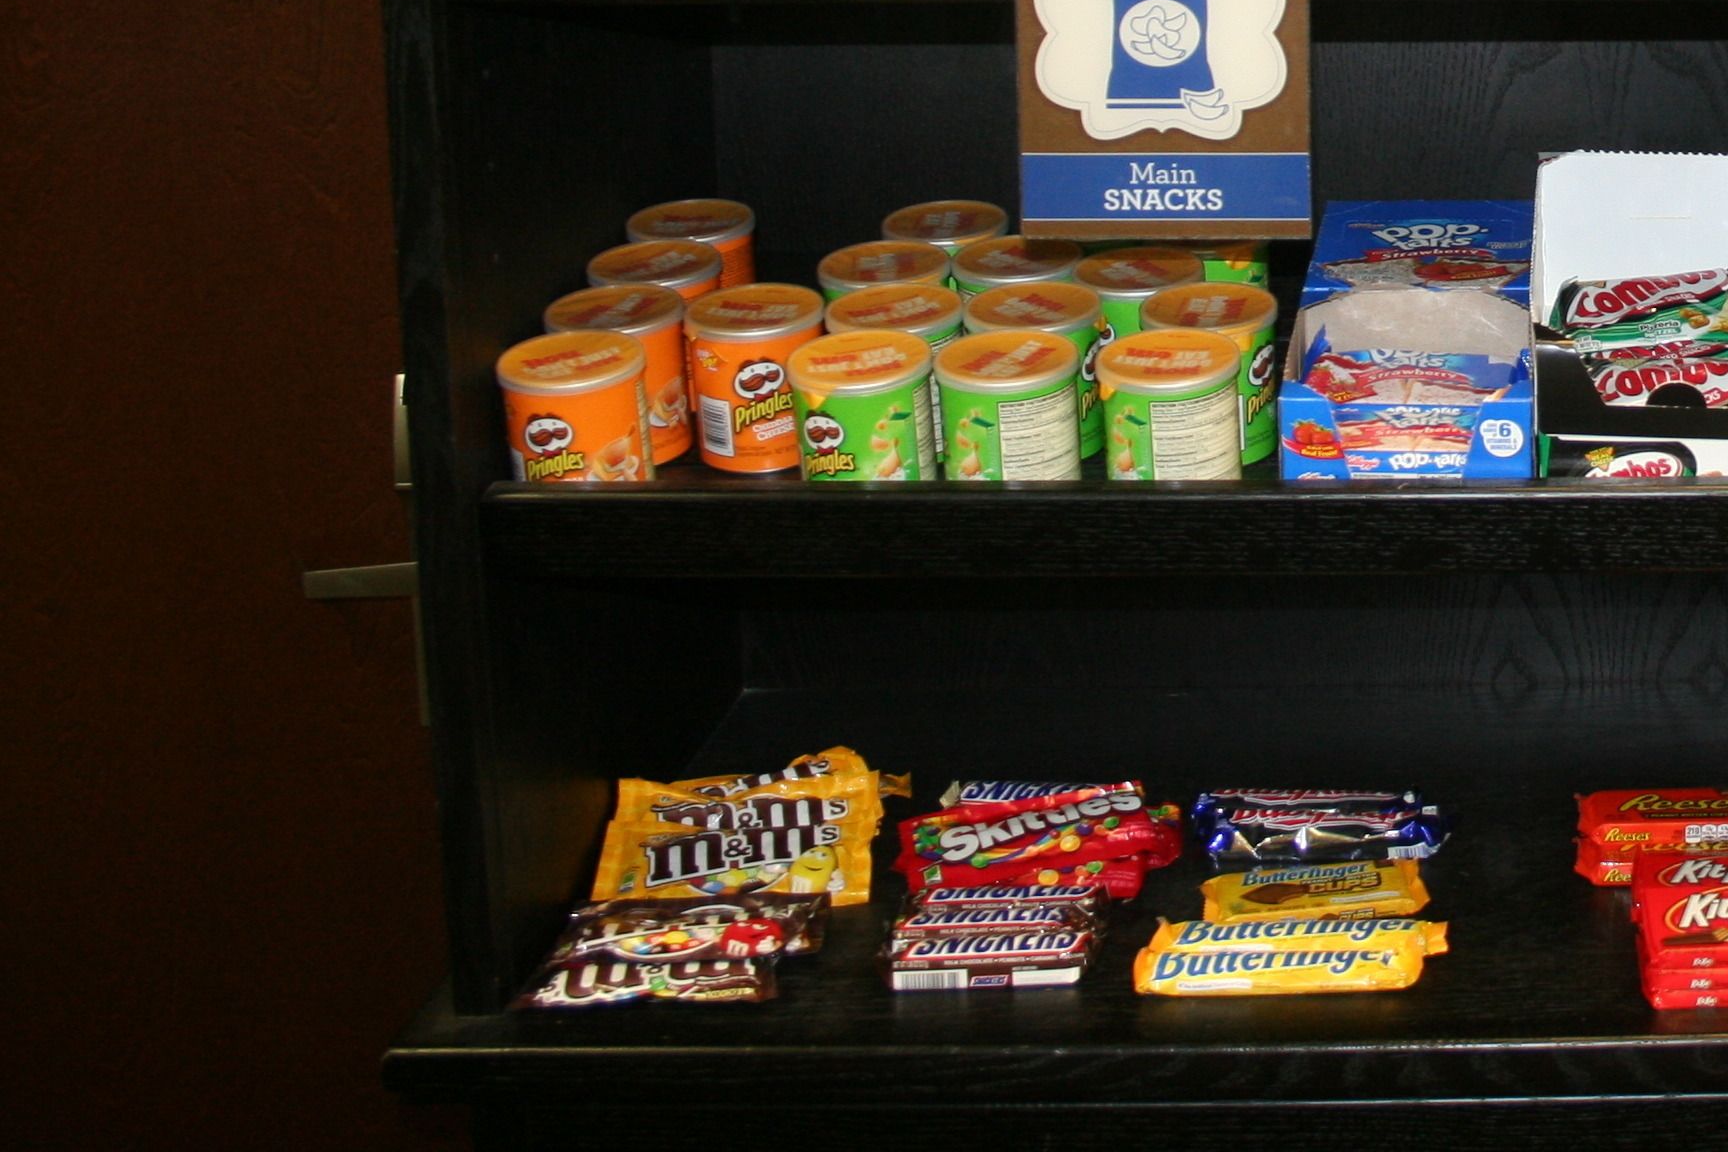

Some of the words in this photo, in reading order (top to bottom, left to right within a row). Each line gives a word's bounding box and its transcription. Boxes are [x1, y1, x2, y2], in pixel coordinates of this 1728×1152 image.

[1130, 162, 1197, 185] Main
[1104, 189, 1223, 211] SNACKS
[1638, 319, 1680, 331] Pizzeria
[1367, 368, 1457, 380] Strawberry
[735, 392, 793, 432] Pringles
[1499, 423, 1512, 437] 6
[526, 451, 584, 480] Pringles
[806, 450, 855, 475] Pringles
[939, 791, 1143, 862] Skittles
[646, 827, 841, 886] m&m's
[1242, 863, 1369, 886] Butterfinger
[1309, 877, 1379, 892] CUPS
[1177, 919, 1417, 945] Butterfinger
